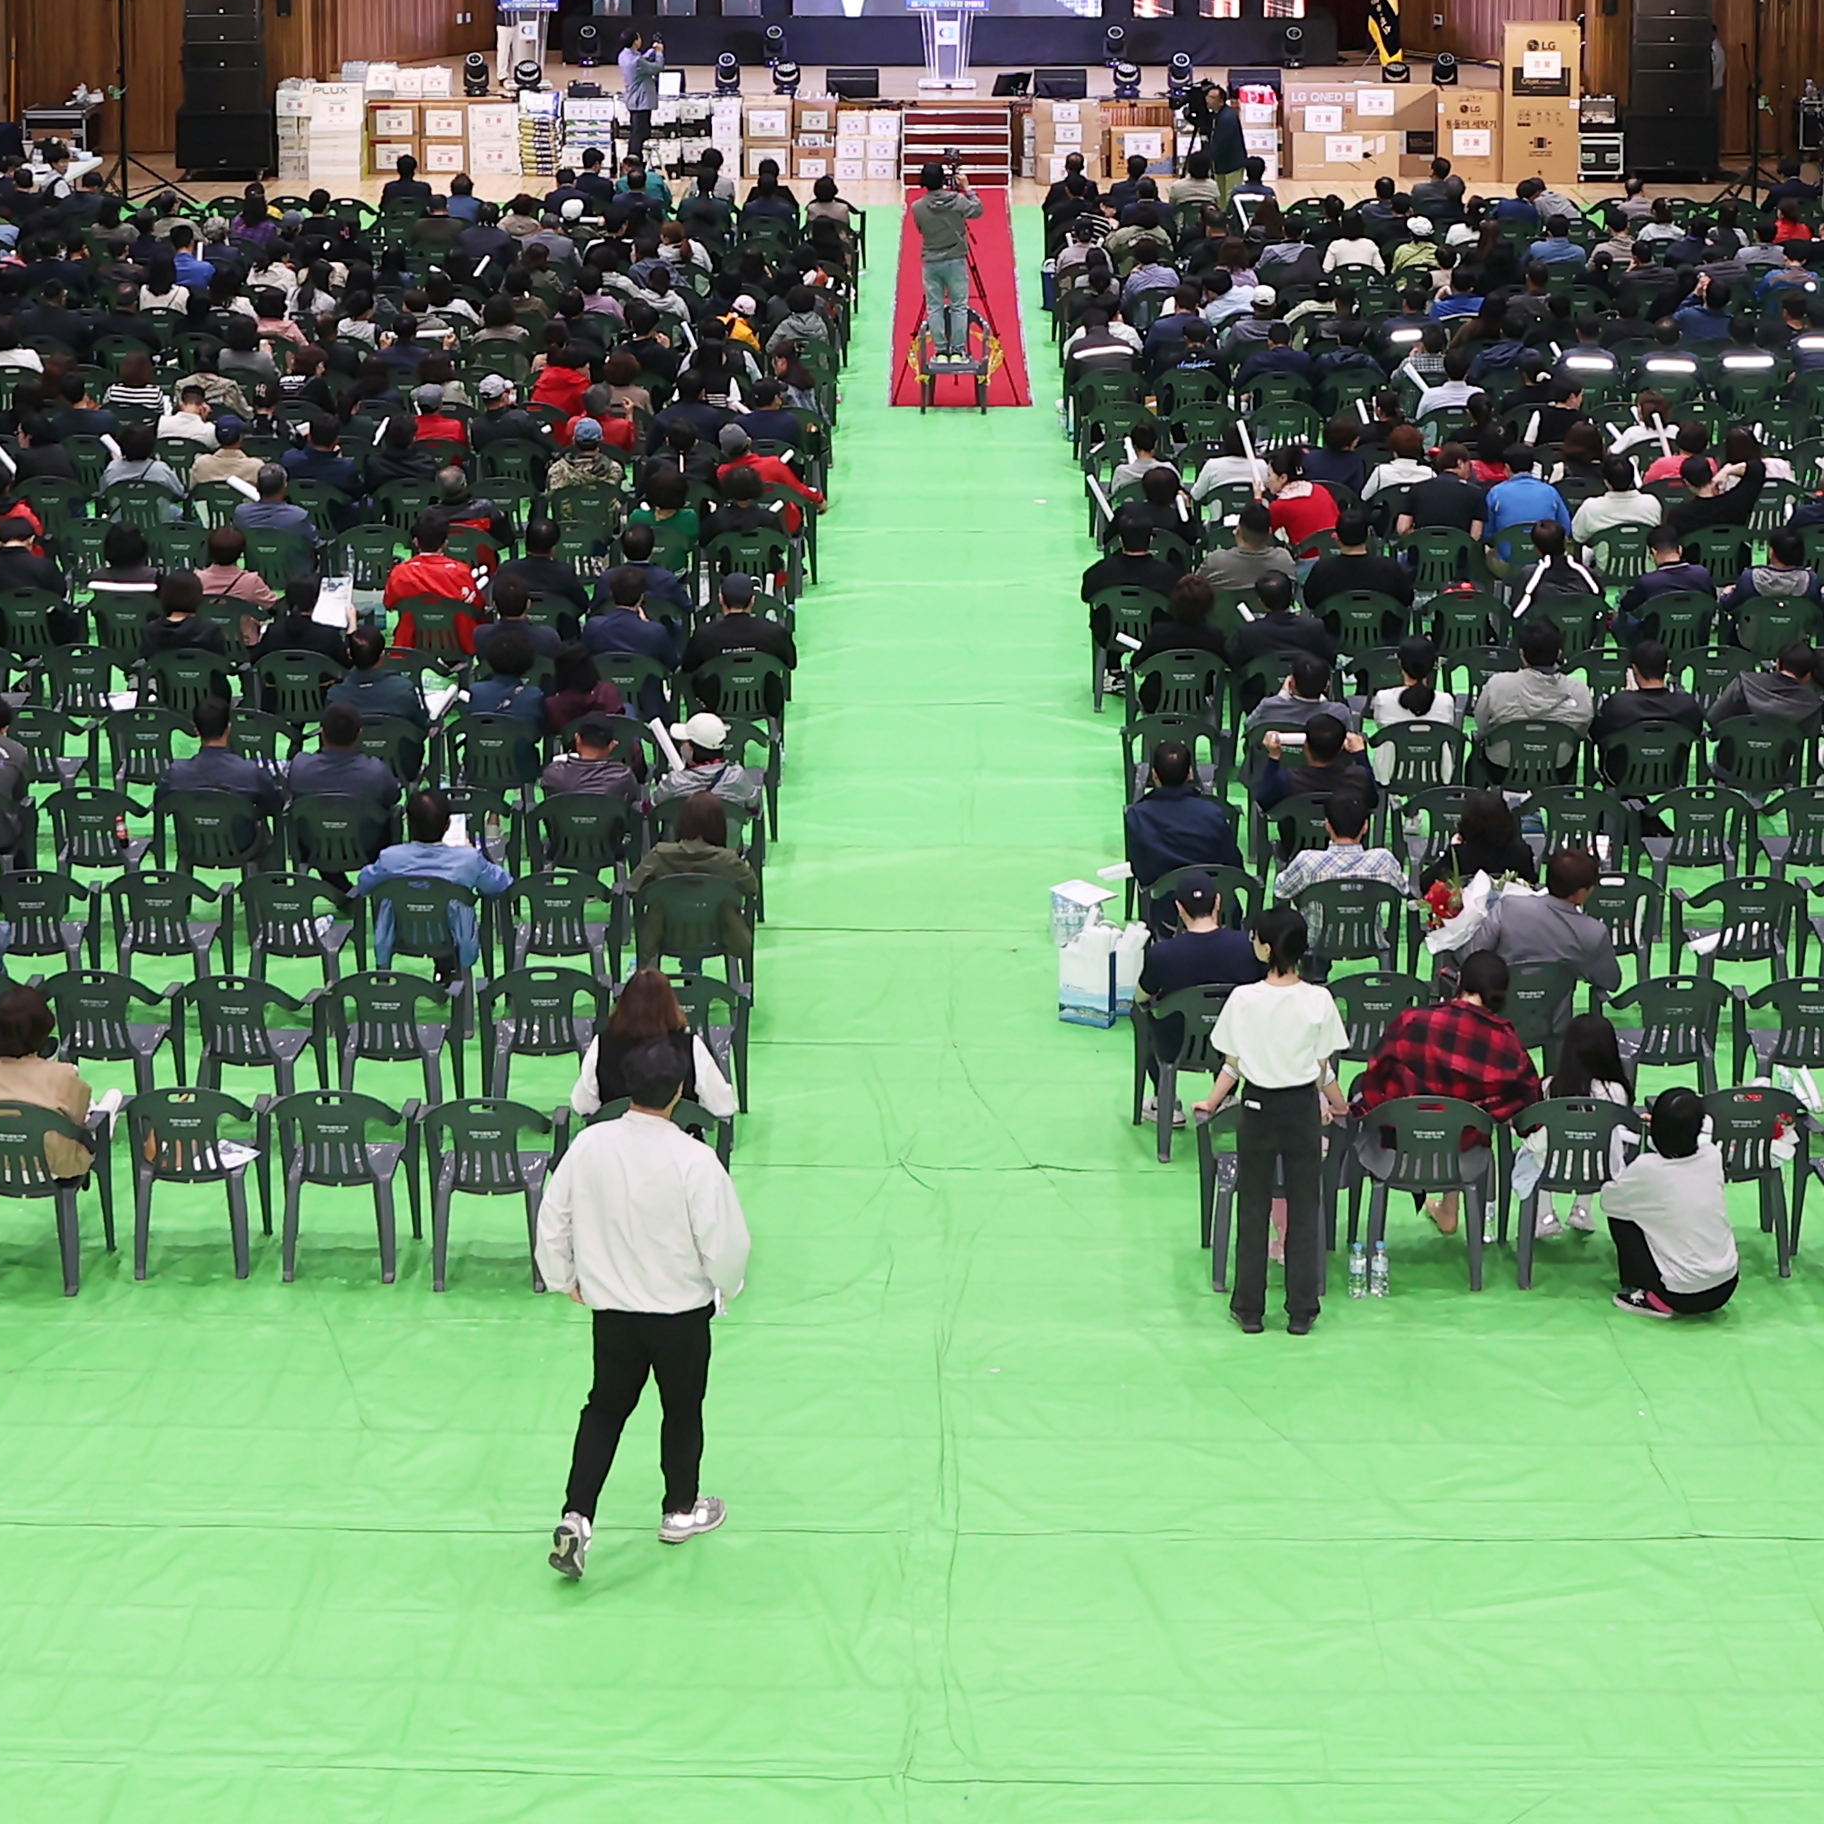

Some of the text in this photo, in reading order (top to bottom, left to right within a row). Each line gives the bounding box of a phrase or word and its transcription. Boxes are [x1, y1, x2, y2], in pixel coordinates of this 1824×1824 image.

[1541, 41, 1556, 50] LG
[312, 87, 348, 95] PLUX
[1291, 92, 1307, 102] LG
[1310, 92, 1344, 102] QNED
